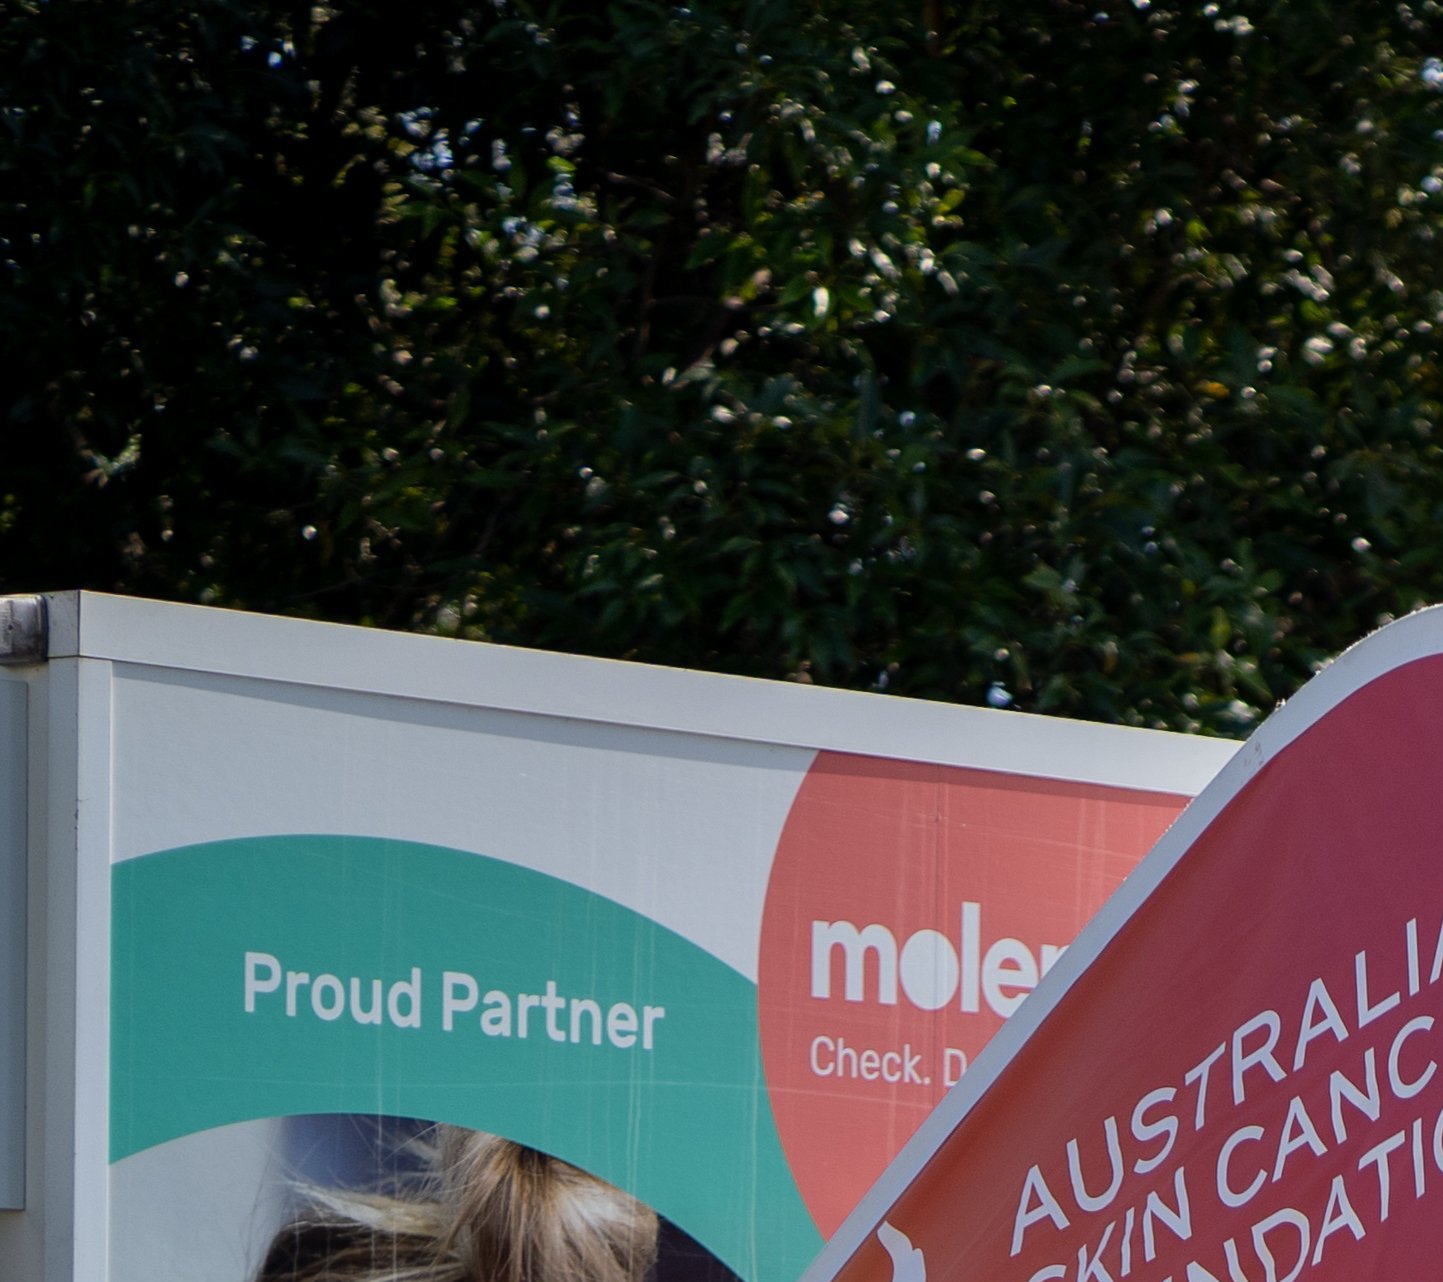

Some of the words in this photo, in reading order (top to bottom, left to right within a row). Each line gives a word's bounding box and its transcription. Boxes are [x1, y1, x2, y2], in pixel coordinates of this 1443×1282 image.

[244, 951, 423, 1032] Proud
[443, 971, 665, 1051] Partner
[810, 1036, 931, 1085] Check.
